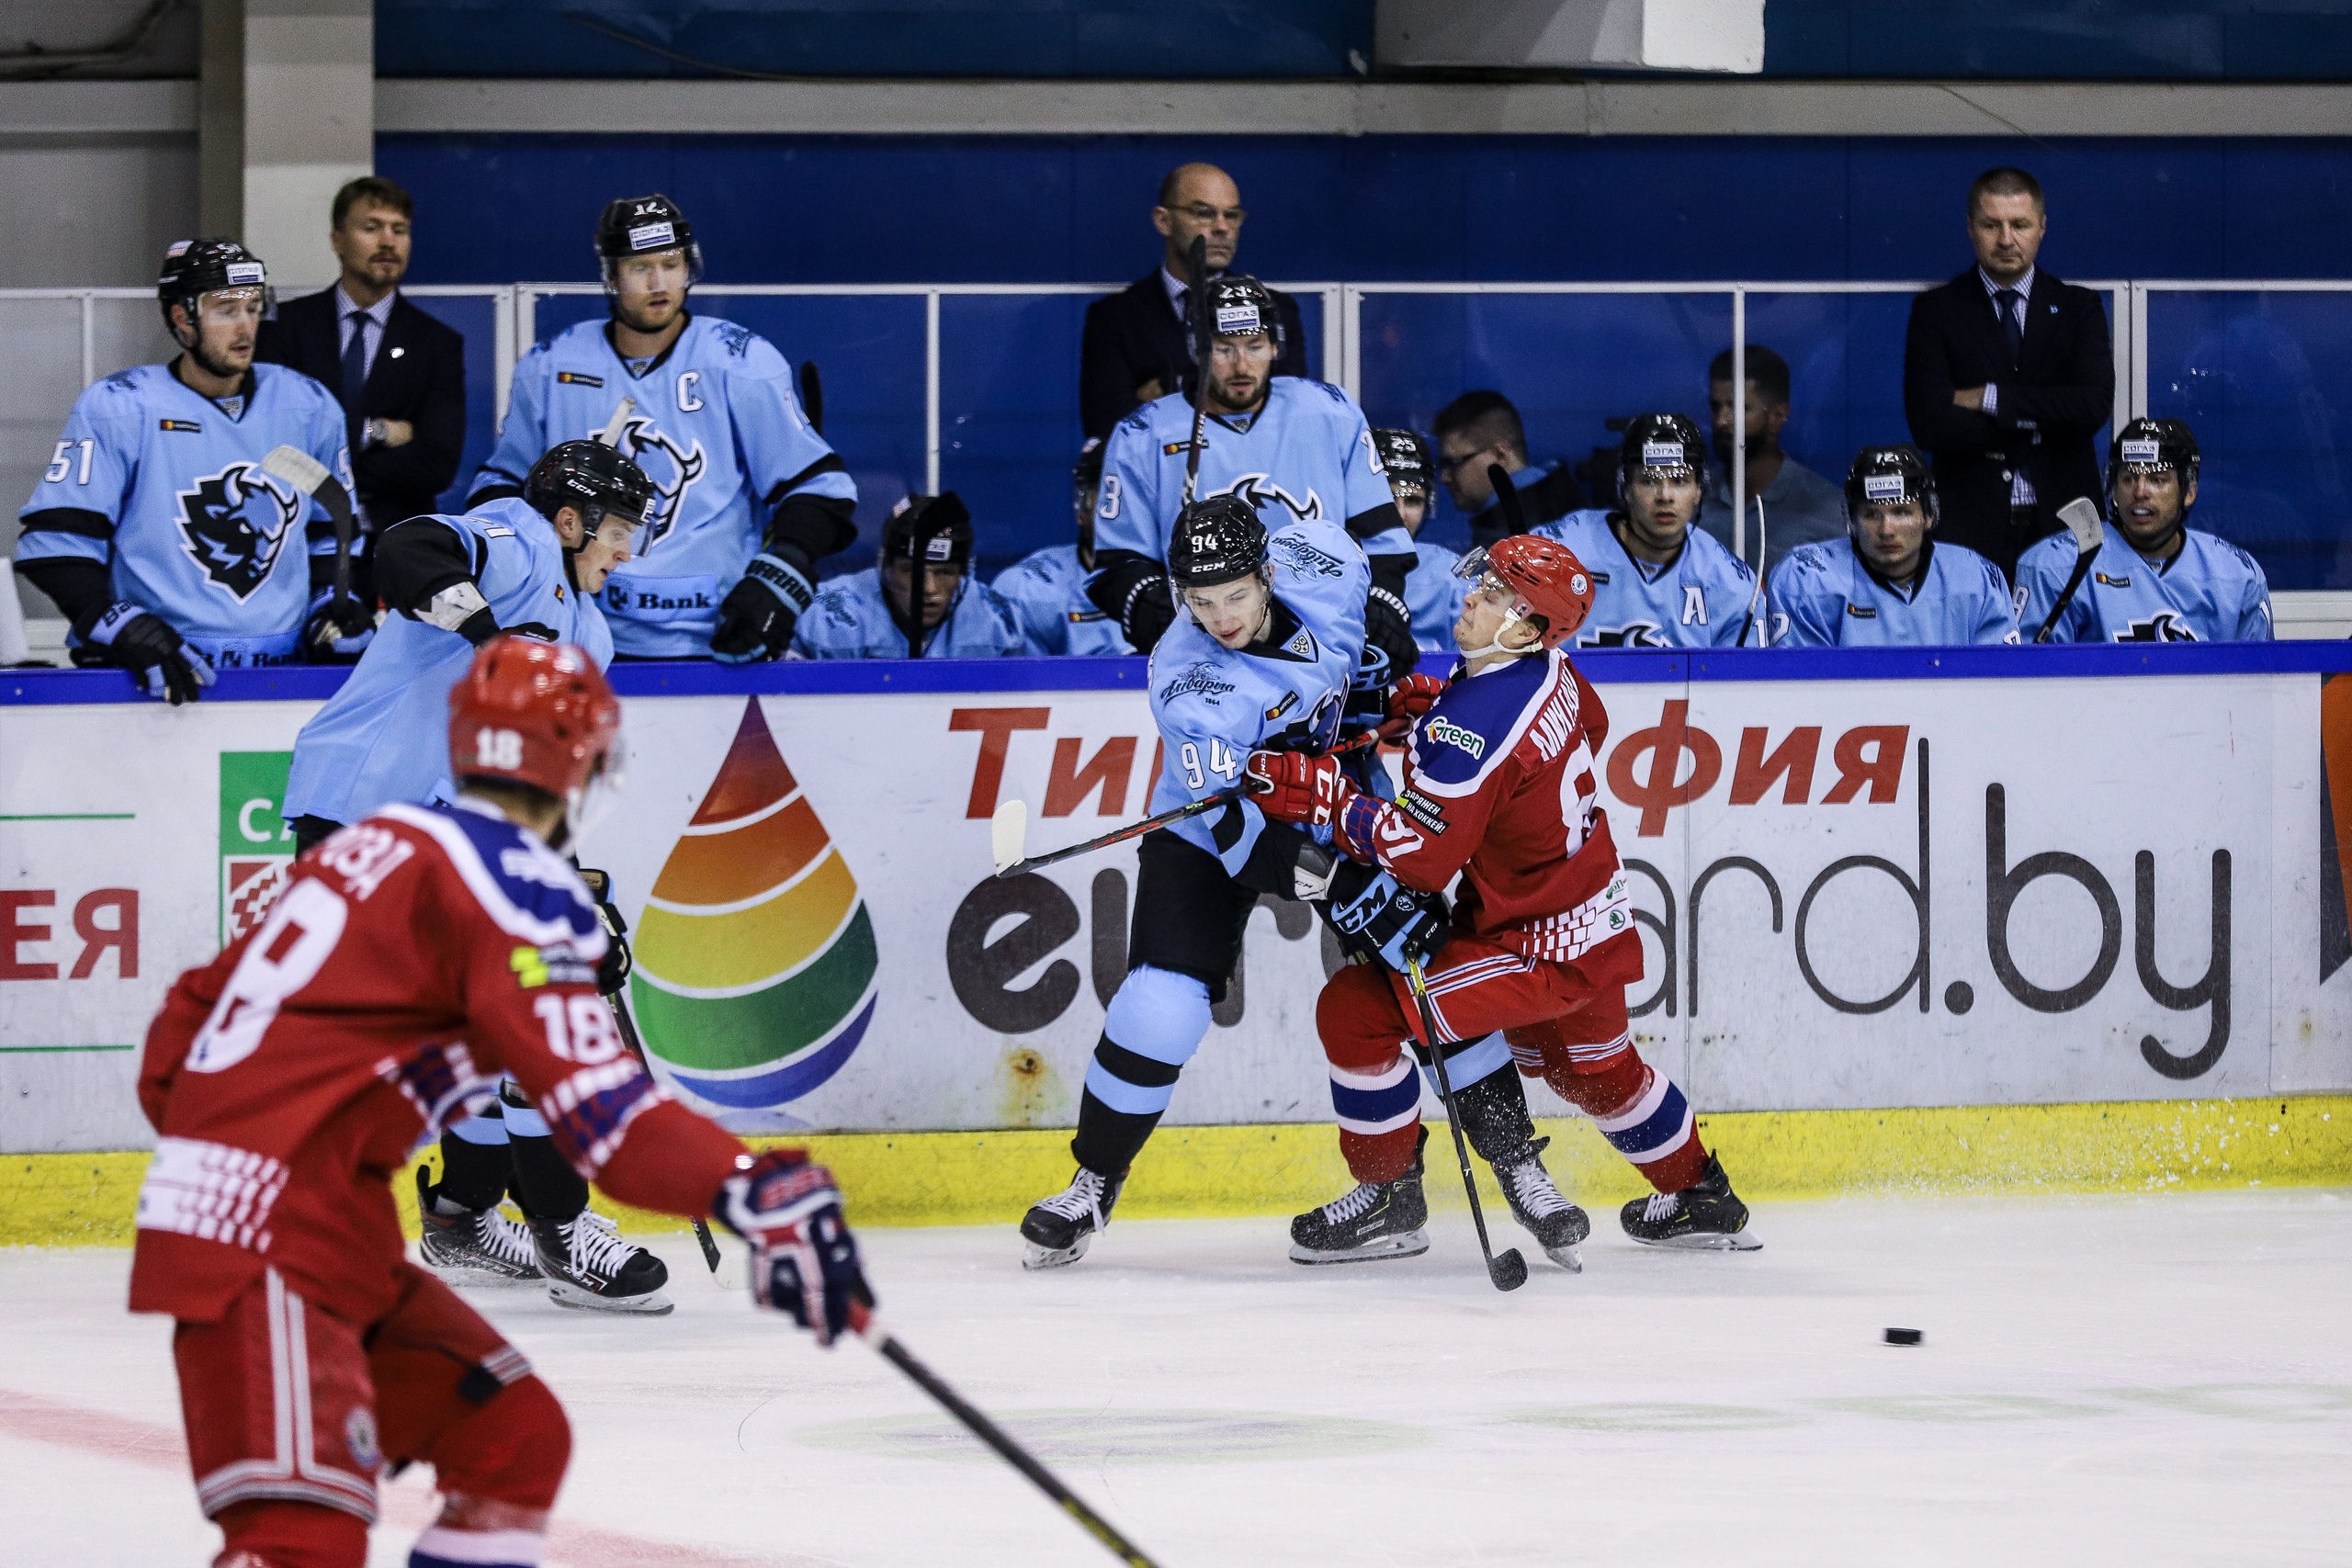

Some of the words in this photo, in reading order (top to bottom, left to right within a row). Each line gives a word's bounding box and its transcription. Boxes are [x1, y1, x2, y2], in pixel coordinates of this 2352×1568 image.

[1219, 286, 1250, 299] 23
[1219, 310, 1258, 321] СОГАЗ
[676, 371, 705, 412] C
[1390, 435, 1417, 453] 25
[44, 438, 96, 485] 51
[566, 479, 597, 497] CCM
[1192, 533, 1219, 553] 94
[1191, 561, 1227, 573] CCM
[636, 592, 711, 610] Bank
[1682, 586, 1709, 626] A
[477, 727, 523, 769] 18
[1182, 739, 1238, 790] 94
[1404, 789, 1442, 816] ЗАРЯЖЕН
[534, 993, 621, 1066] 18
